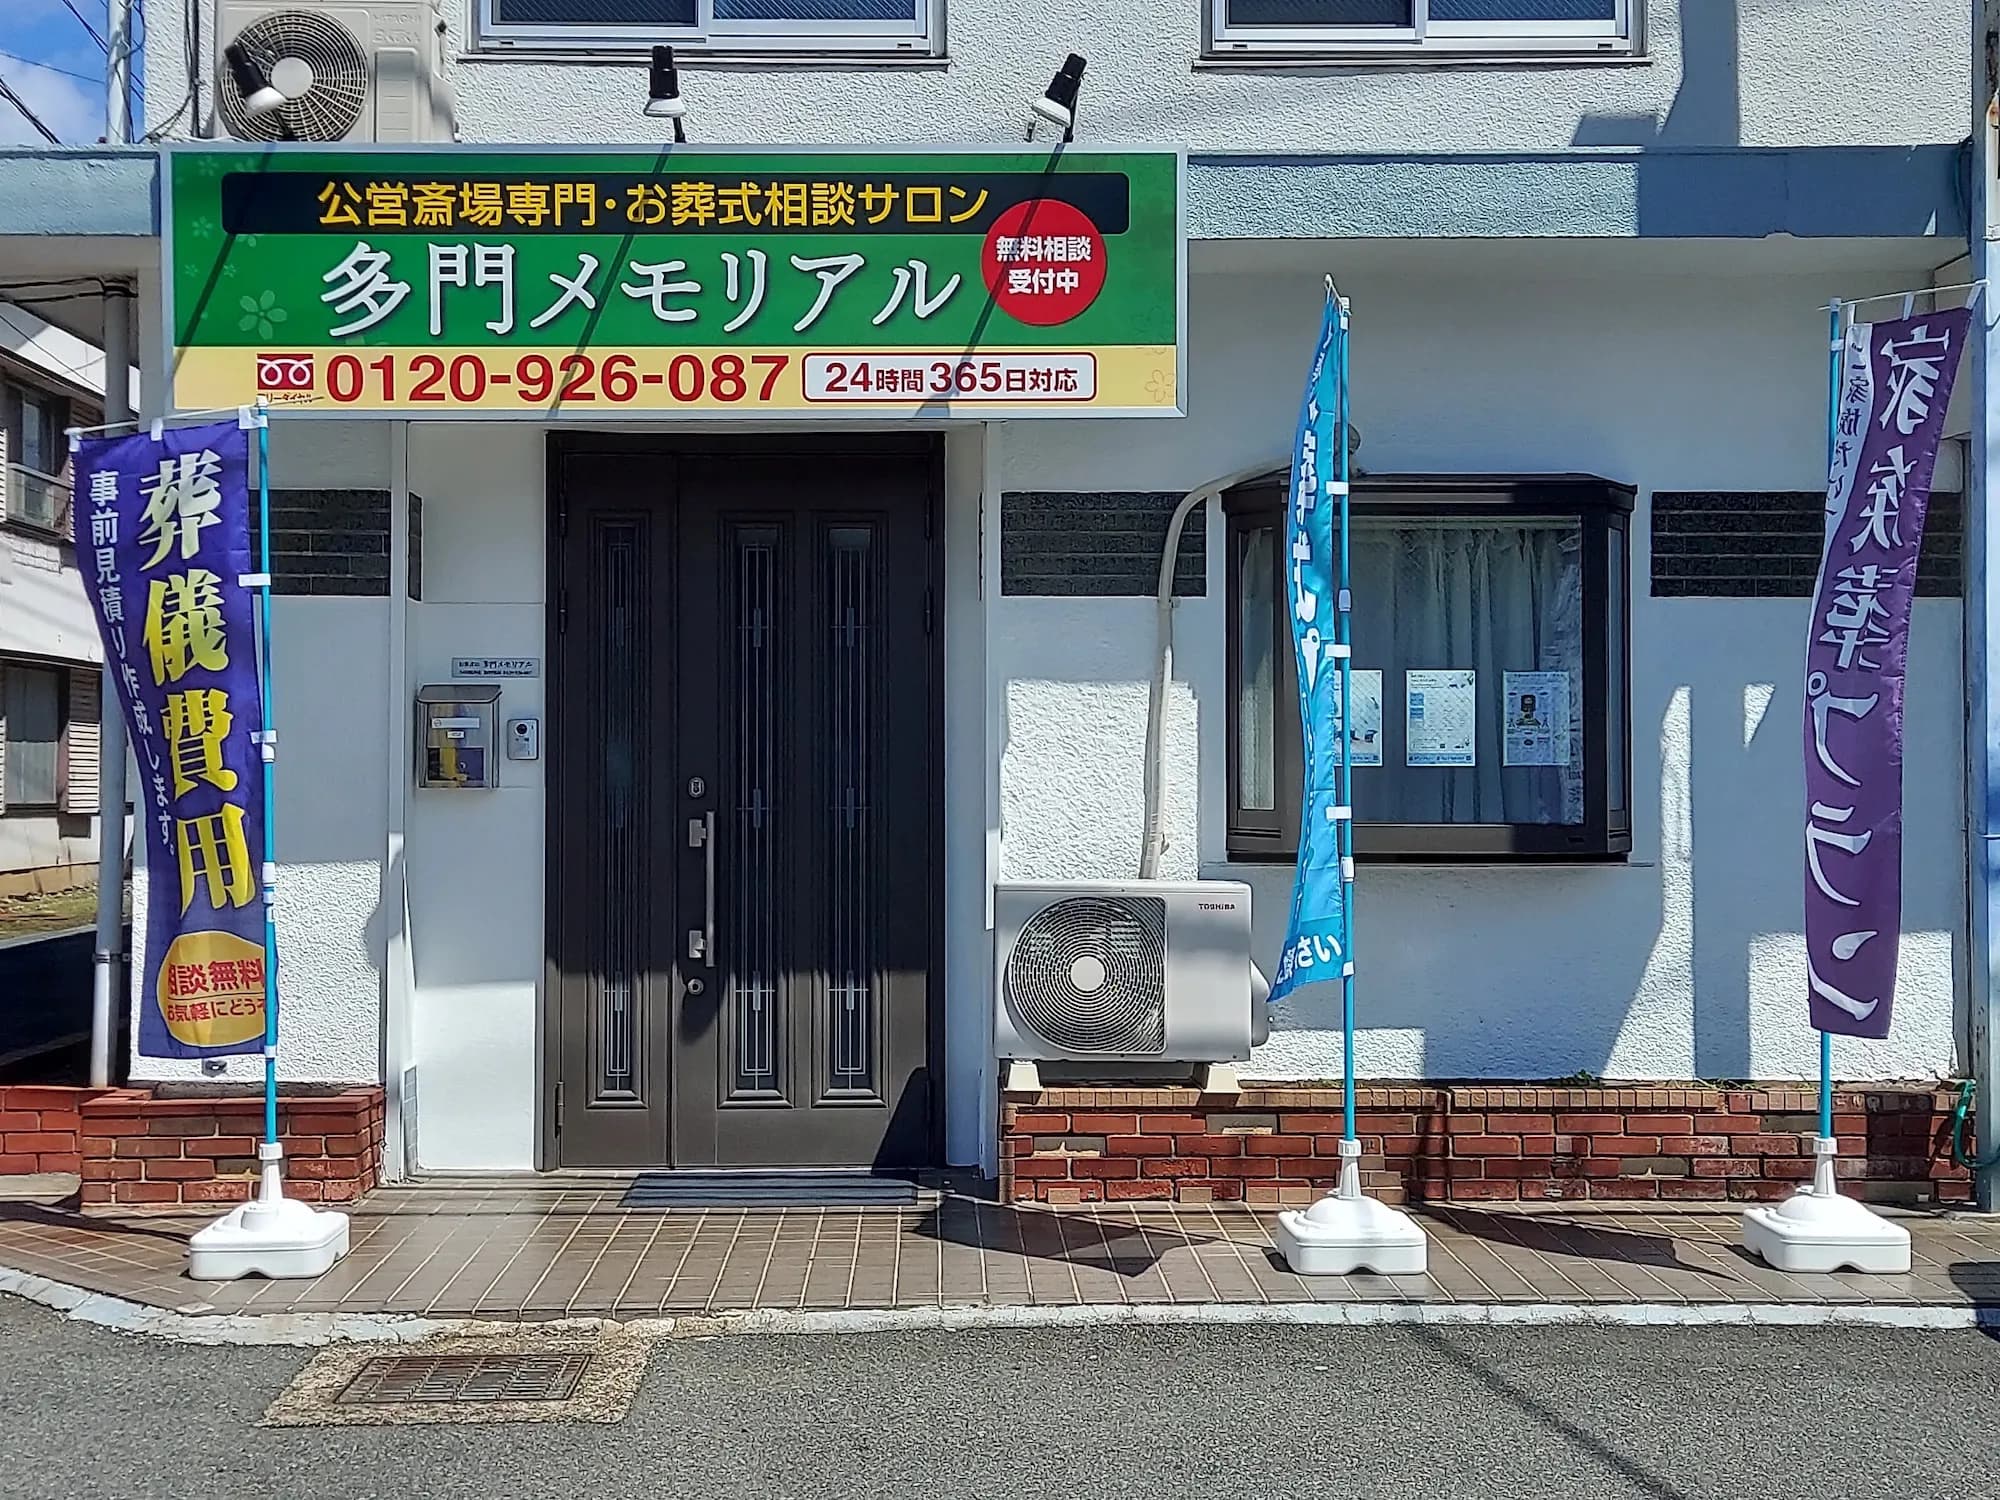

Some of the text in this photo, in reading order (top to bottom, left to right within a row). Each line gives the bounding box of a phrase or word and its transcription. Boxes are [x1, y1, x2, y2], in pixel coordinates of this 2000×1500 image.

[317, 180, 990, 227] 公営斎場専門・お葬式相談サロン
[996, 236, 1092, 262] 無料相談
[320, 241, 961, 337] 多門メモリアル
[1008, 268, 1080, 295] 受付中
[326, 354, 790, 402] 0120-926-087
[825, 362, 1078, 393] 24時間365日対応
[139, 449, 256, 920] 葬儀費用
[1198, 903, 1236, 911] TOSHIBA
